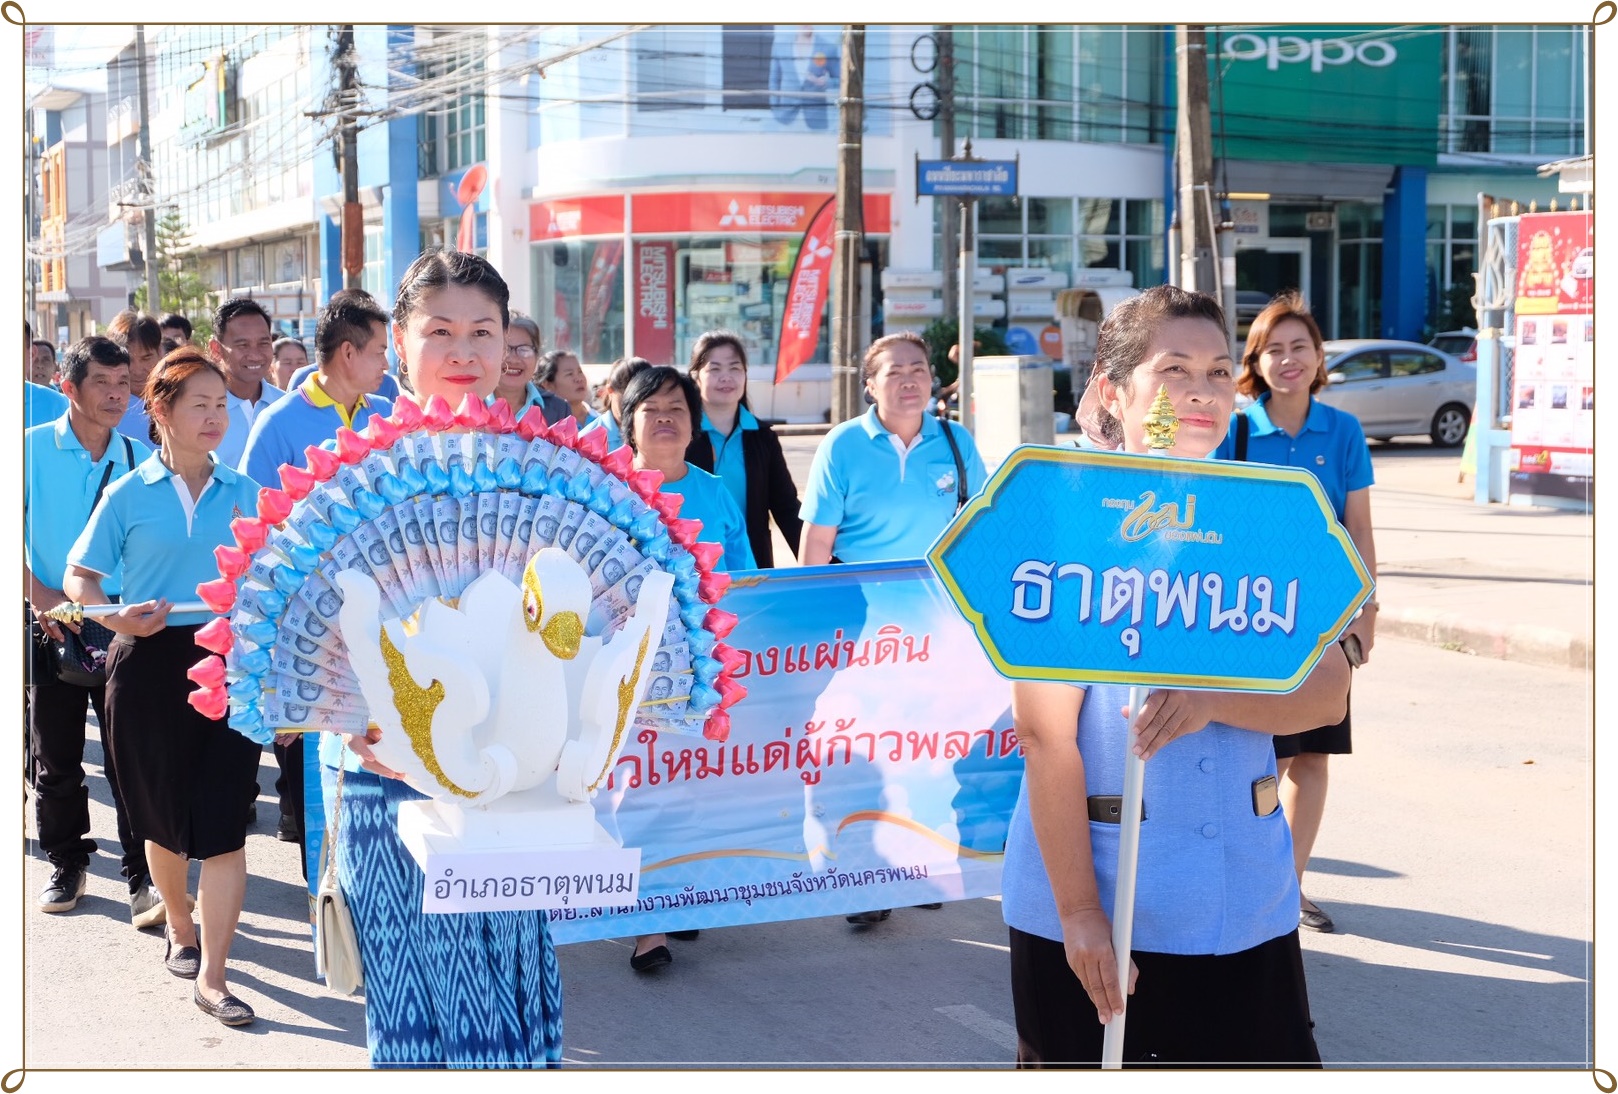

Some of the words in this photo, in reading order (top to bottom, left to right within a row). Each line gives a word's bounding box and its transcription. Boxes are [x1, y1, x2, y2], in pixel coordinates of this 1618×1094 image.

[749, 205, 805, 216] MITSUBISHI
[749, 215, 797, 226] ELECTRIC
[640, 247, 653, 317] ELECTRIC
[653, 247, 668, 329] MITSUBISHI
[1010, 559, 1298, 657] ธาตุพนม
[607, 717, 1026, 791] วใหมแด่ผู้ก้าวพลาด
[434, 869, 634, 904] อำเภอธาตุพนม
